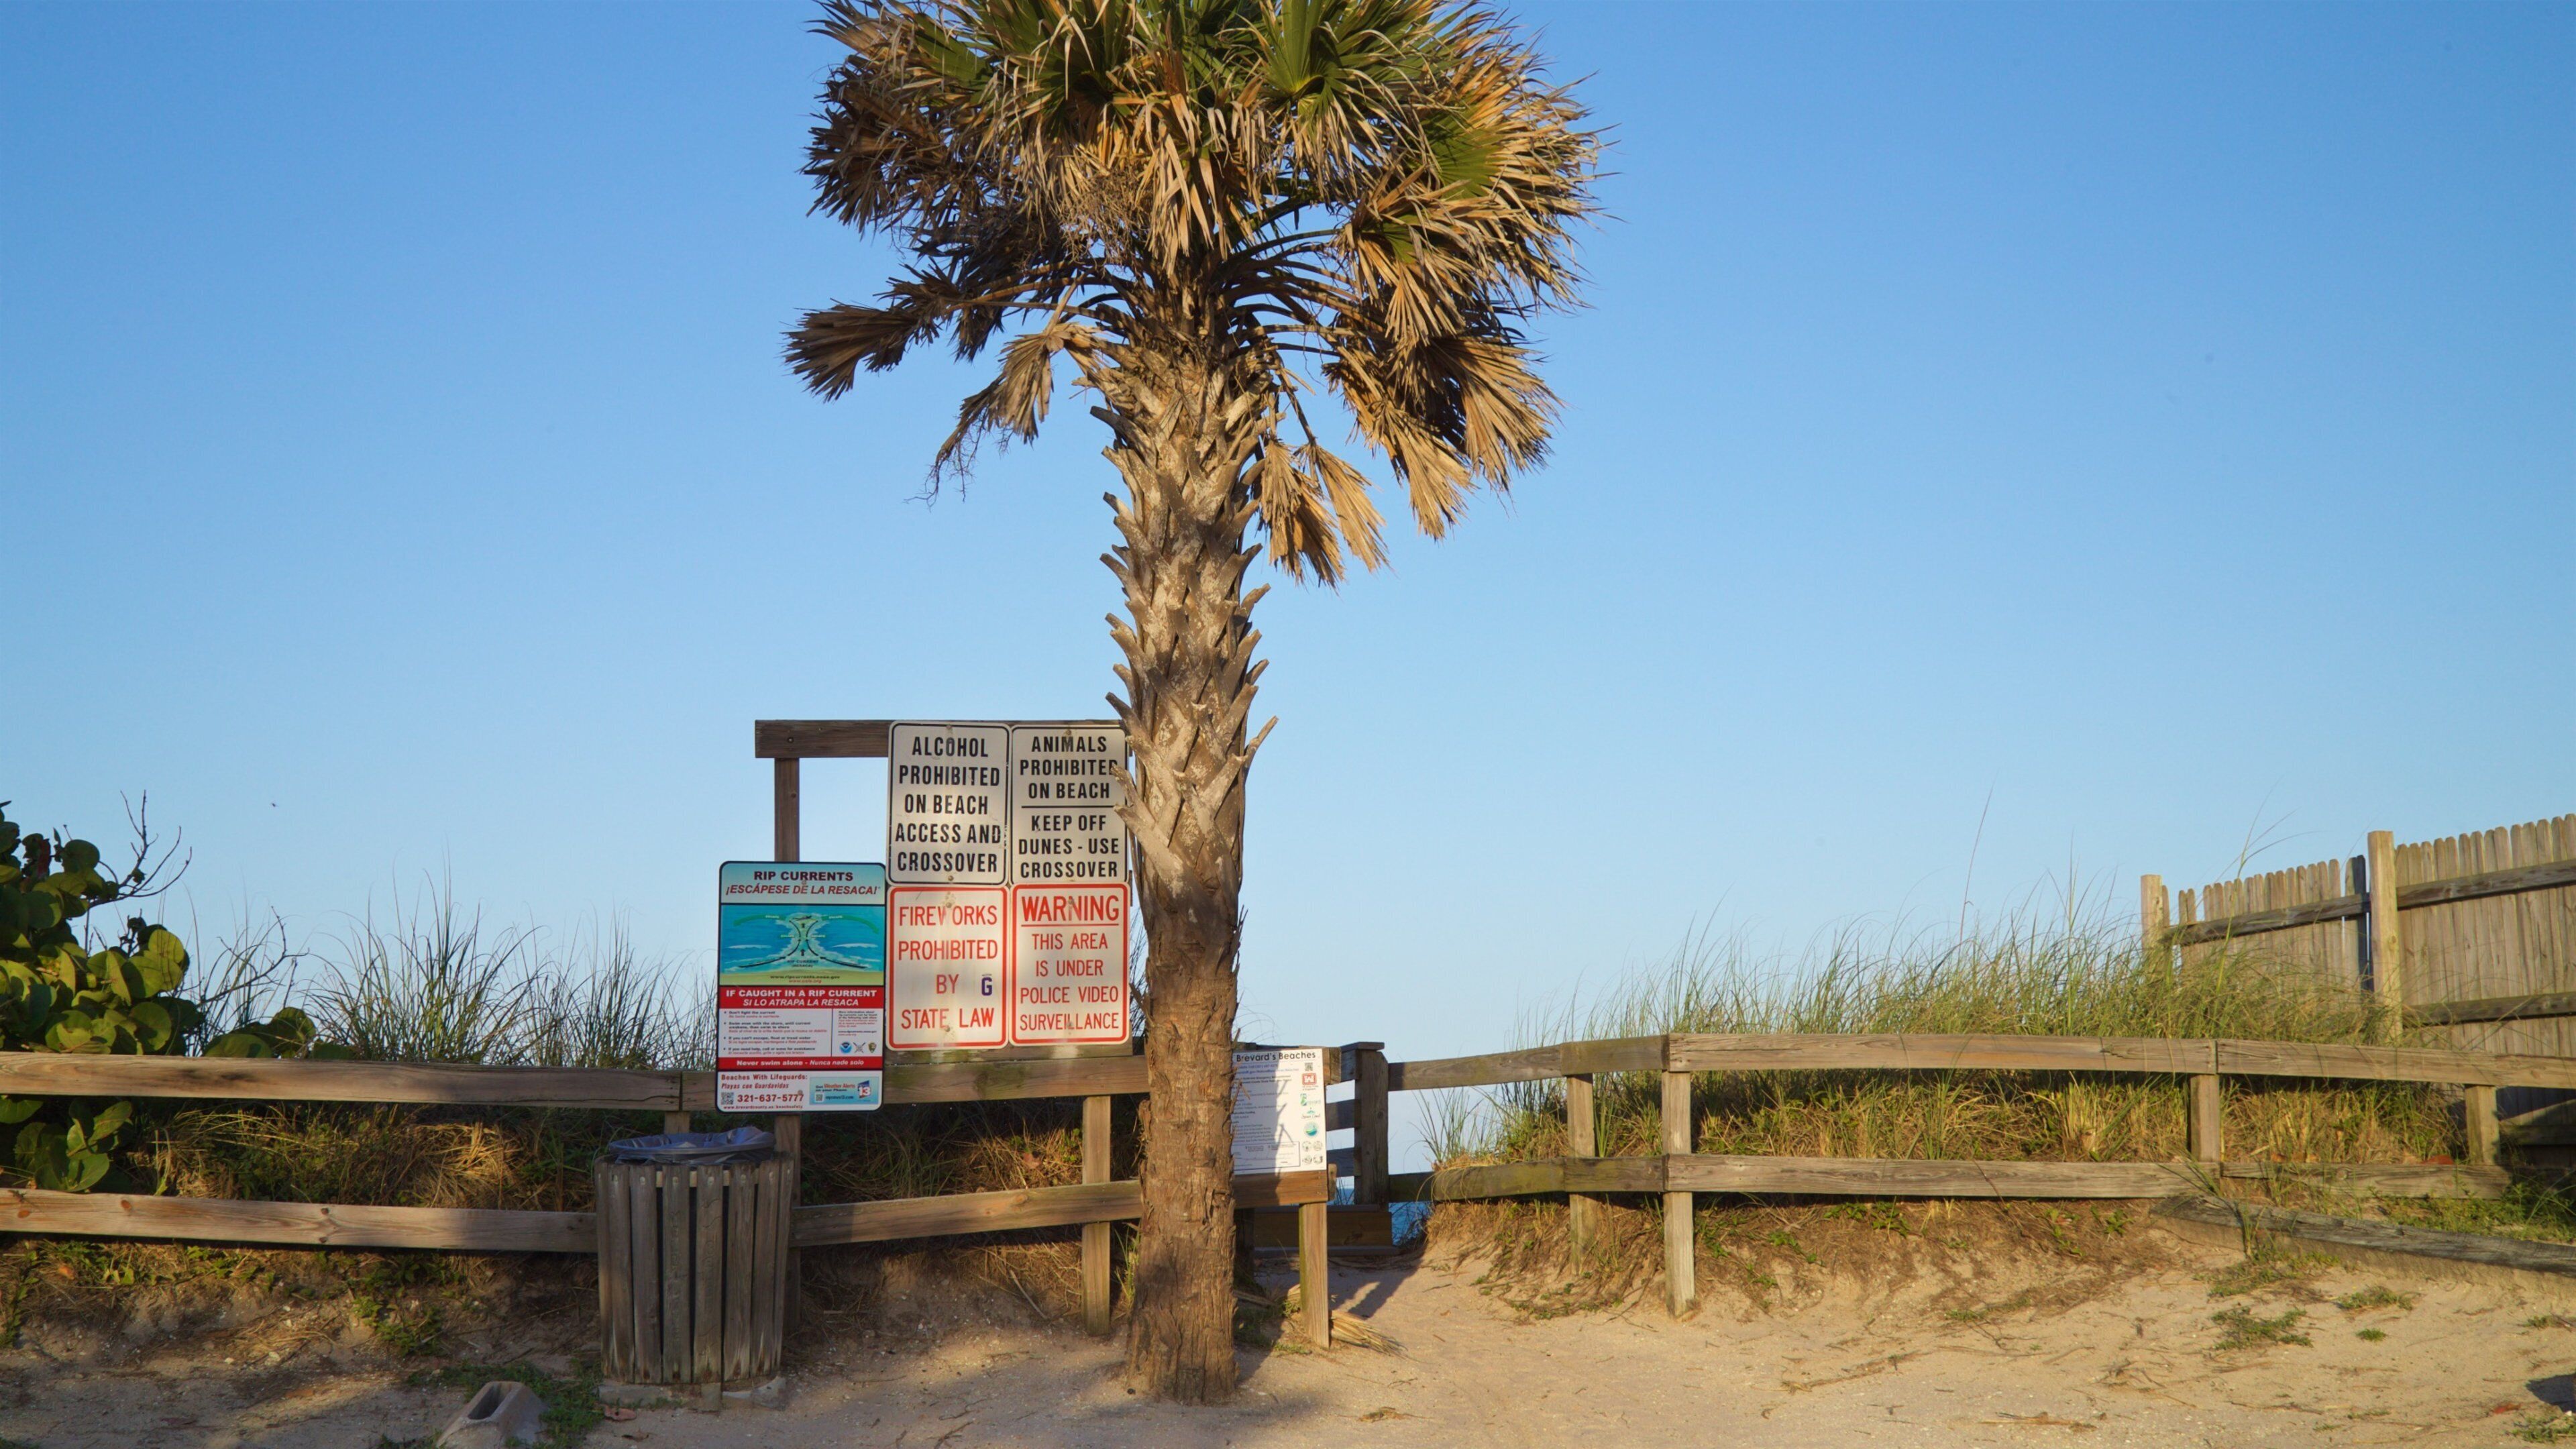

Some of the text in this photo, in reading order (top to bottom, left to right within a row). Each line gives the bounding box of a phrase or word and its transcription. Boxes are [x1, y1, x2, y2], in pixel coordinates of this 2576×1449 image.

[912, 737, 989, 757] ALCOHOL
[1031, 736, 1107, 753] ANIMALS
[899, 765, 1000, 786] PROHIBITED
[1028, 783, 1110, 799] ON BEACH
[904, 794, 989, 815] ON BEACH
[1031, 815, 1107, 832] KEEP OFF
[895, 822, 1002, 844] ACCESS AND
[1018, 839, 1073, 855] DUNES
[1088, 839, 1119, 854] USE
[897, 851, 998, 872] CROSSOVER
[1020, 861, 1118, 878] CROSSOVER
[754, 871, 854, 881] RIP CURRENTS
[726, 883, 877, 895] ¡ESCÁPESE DE LA RESACA!
[1021, 895, 1120, 922] WARNING
[898, 939, 998, 961] PROHIBITED
[1032, 933, 1108, 950] THIS AREA
[1036, 959, 1104, 977] IS UNDER
[936, 974, 959, 994] BY
[981, 977, 993, 996] G
[726, 989, 877, 998] IF CAUGHT IN A RIP CURRENT
[1020, 985, 1119, 1004] POLICE VIDEO
[901, 1008, 994, 1029] STATE LAW
[1020, 1012, 1120, 1031] SURVEILLANCE
[1279, 1051, 1316, 1060] Beaches
[737, 1093, 804, 1102] 321-637-5777
[859, 1087, 871, 1097] 13
